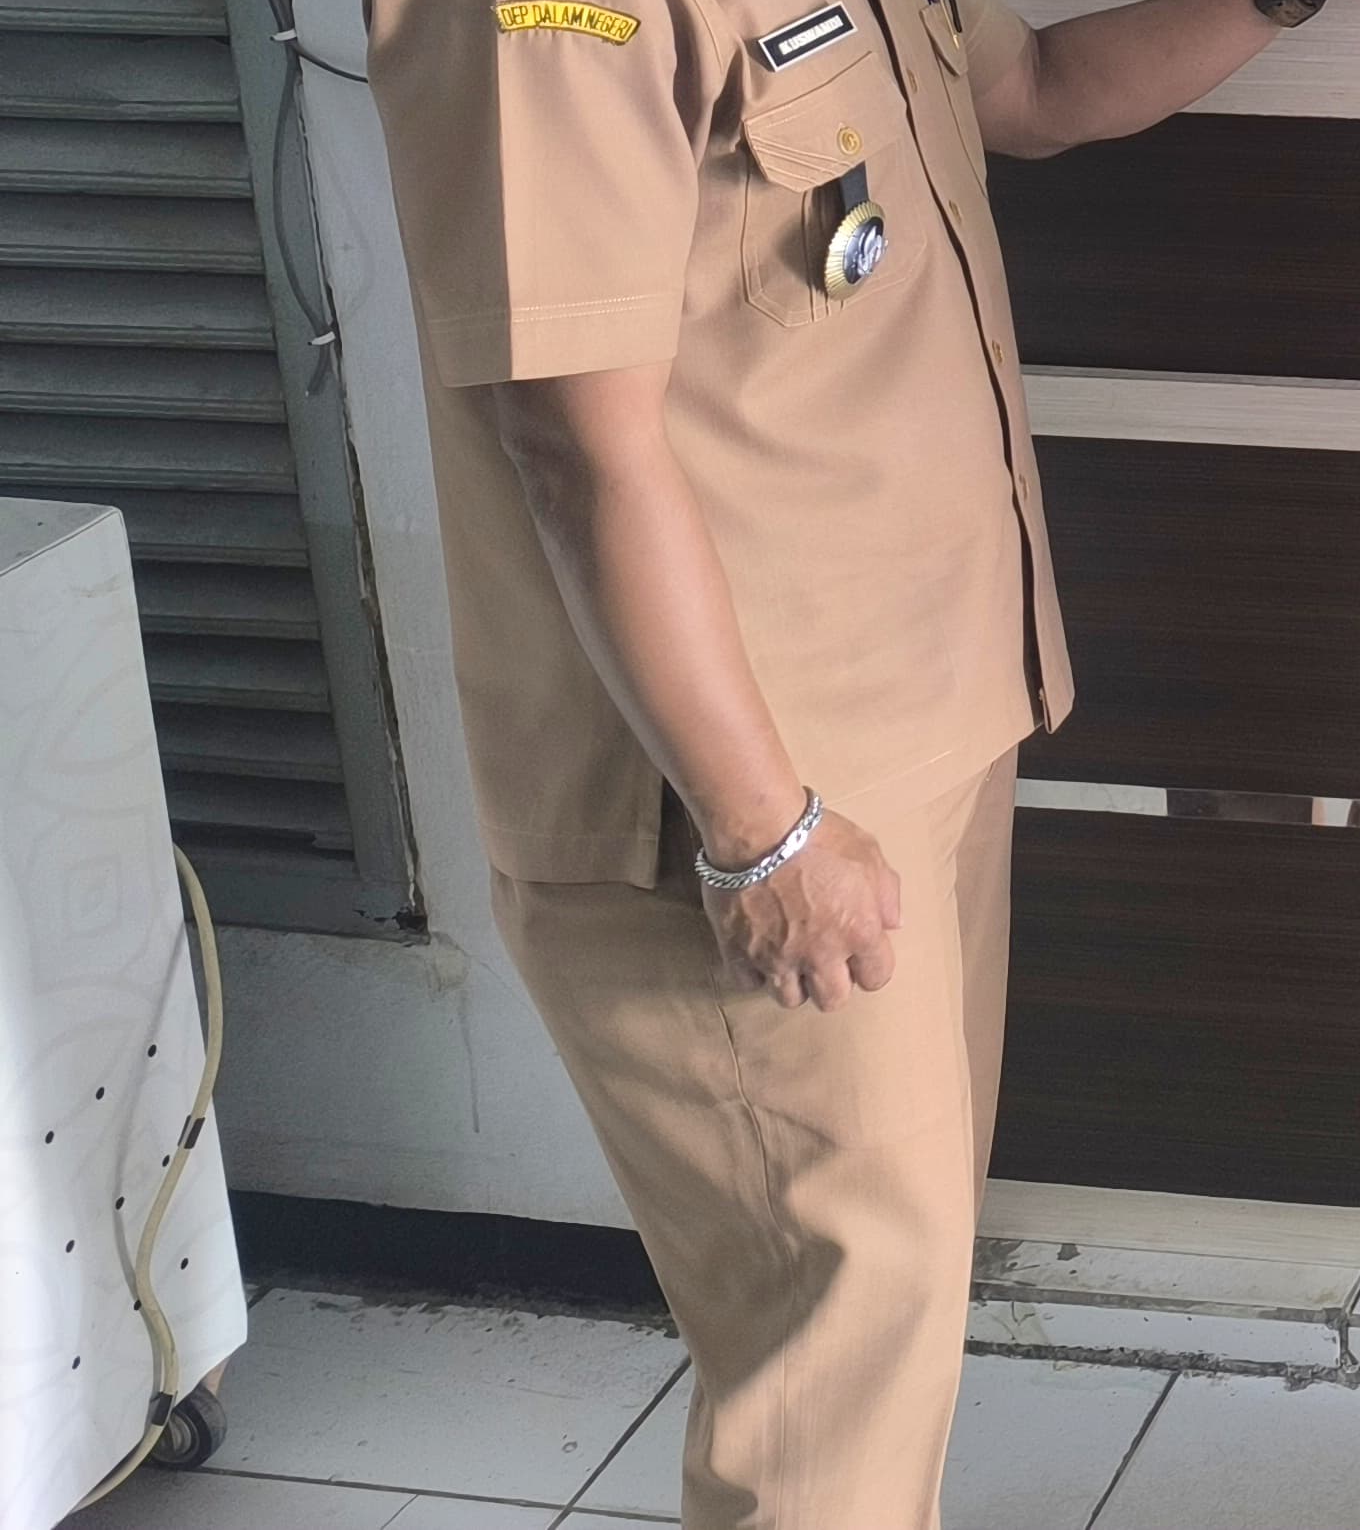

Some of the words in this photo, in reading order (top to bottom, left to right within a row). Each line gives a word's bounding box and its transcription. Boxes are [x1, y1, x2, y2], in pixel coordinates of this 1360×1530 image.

[501, 5, 528, 27] DEP
[532, 4, 583, 28] DALAM
[584, 8, 634, 40] NEGERI
